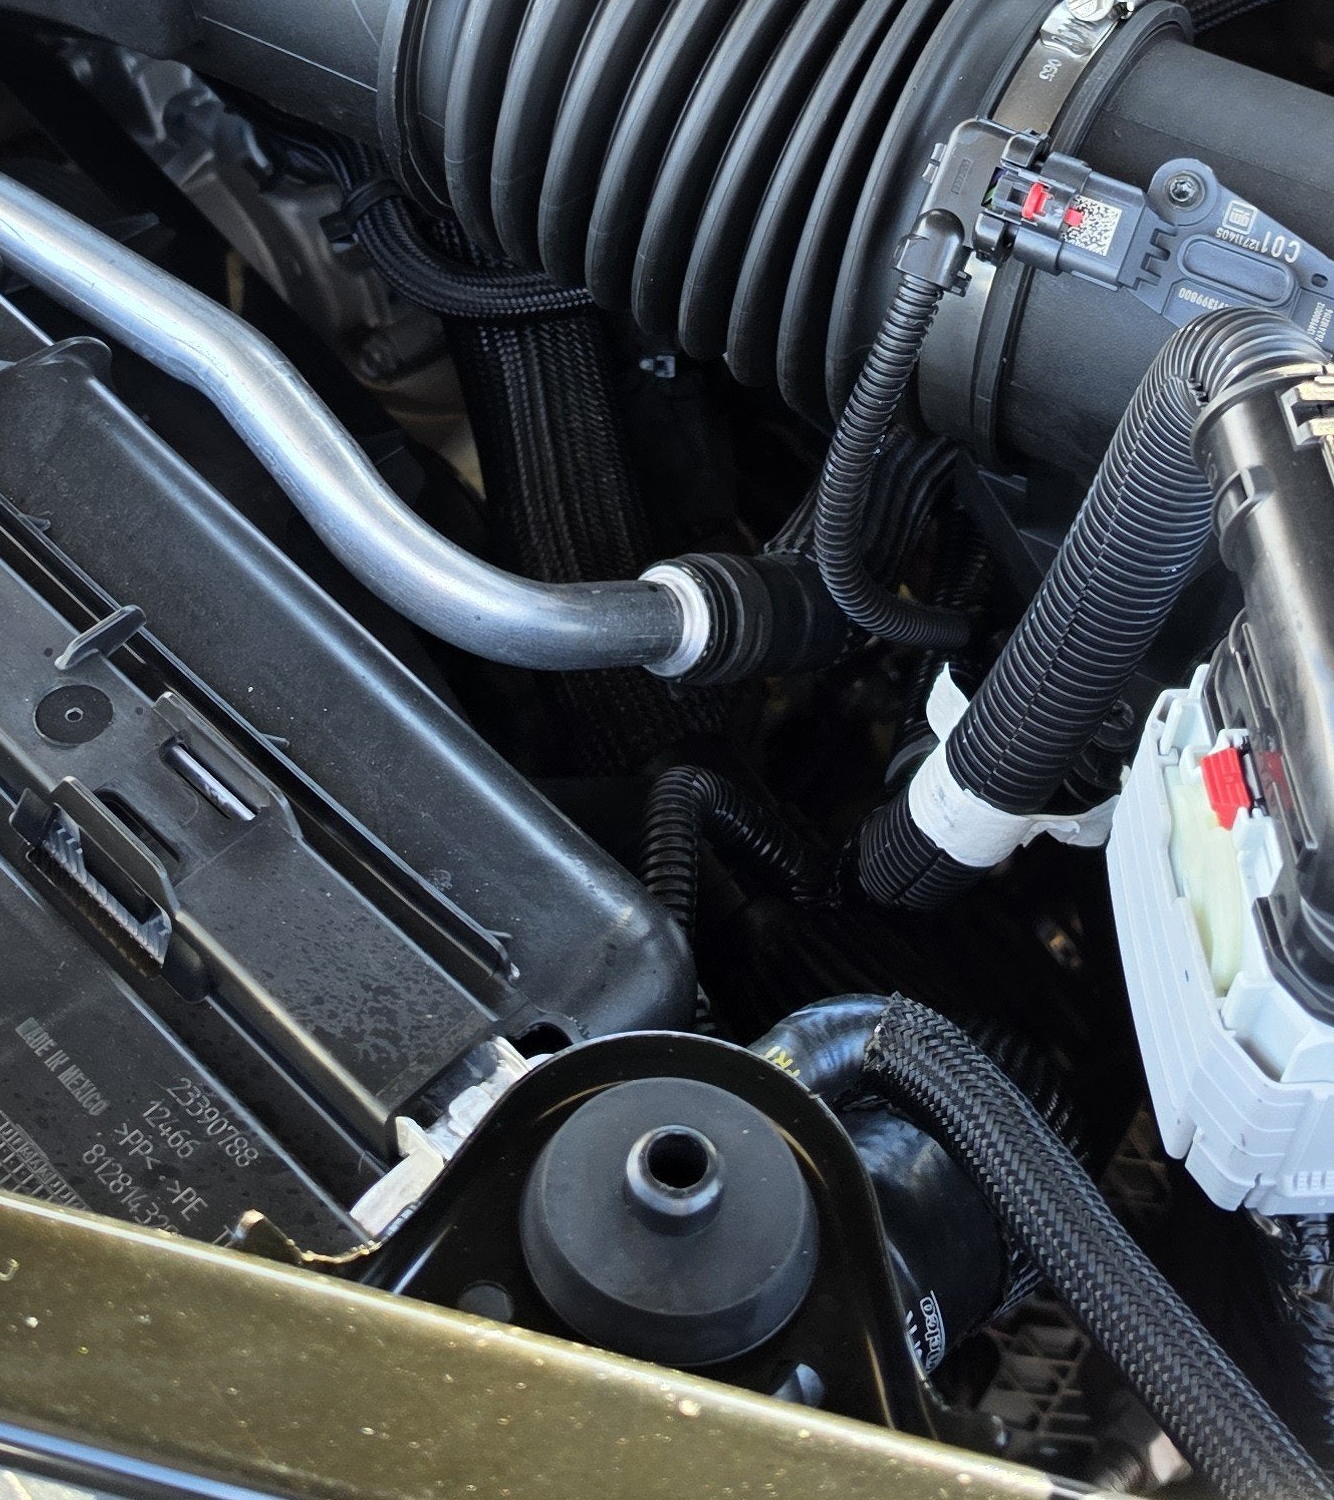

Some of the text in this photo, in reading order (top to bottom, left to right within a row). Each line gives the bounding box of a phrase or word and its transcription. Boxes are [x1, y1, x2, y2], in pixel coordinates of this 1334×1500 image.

[1261, 231, 1301, 263] C01
[57, 1063, 110, 1116] MEXICO
[142, 1100, 202, 1159] 12466
[167, 1077, 260, 1167] 23390788
